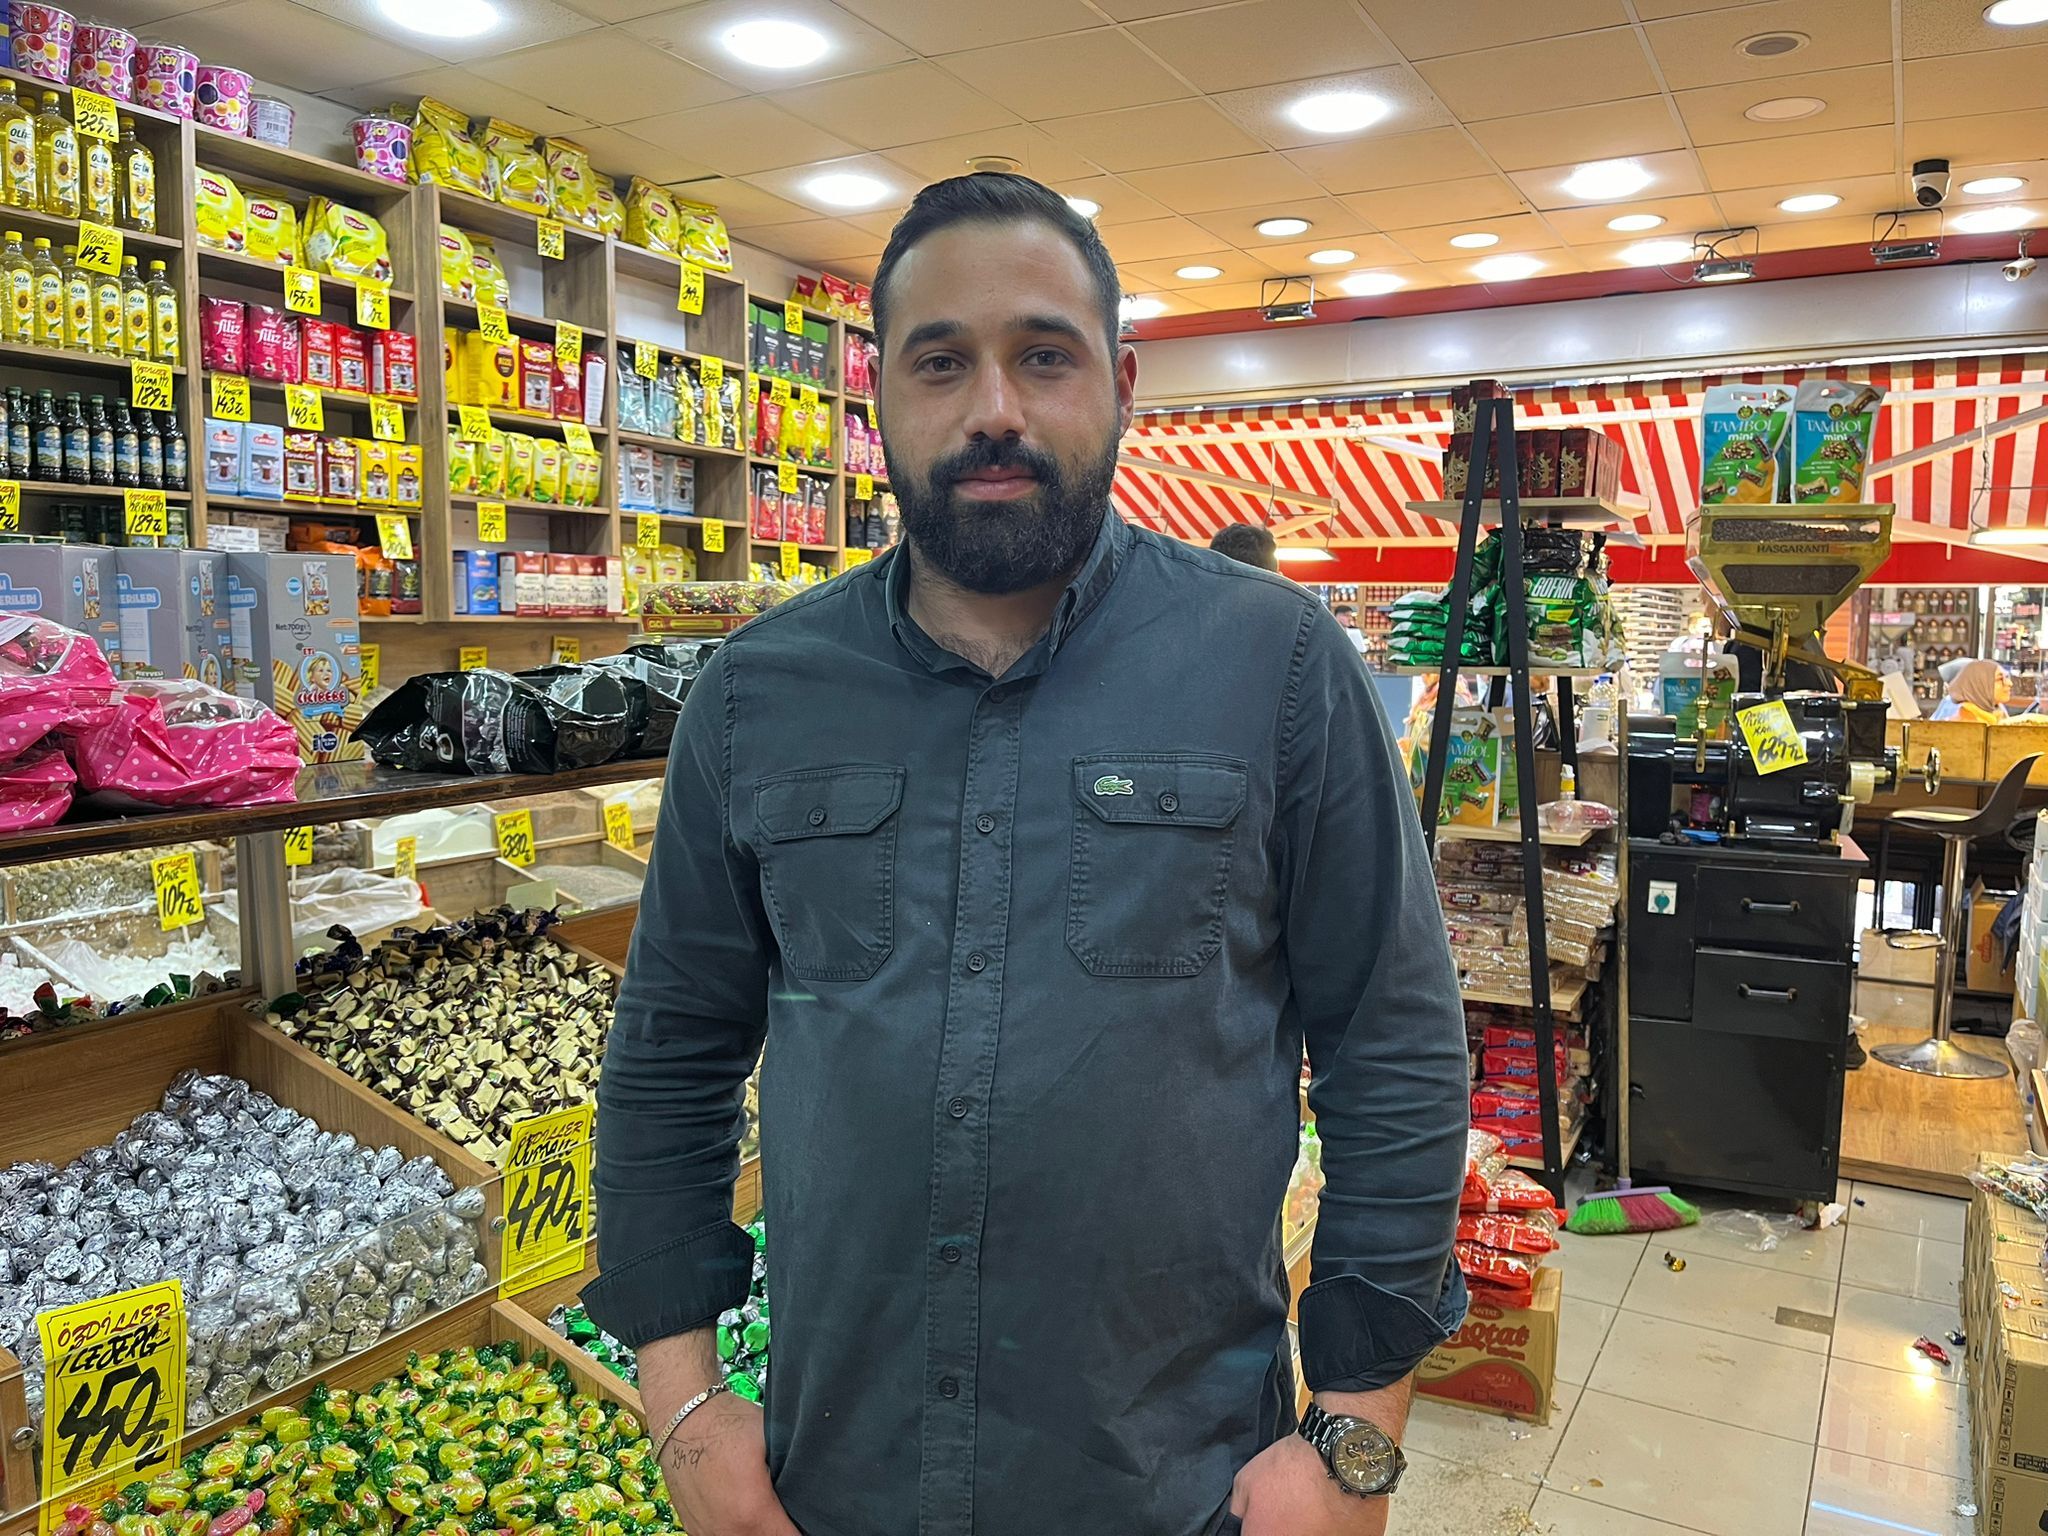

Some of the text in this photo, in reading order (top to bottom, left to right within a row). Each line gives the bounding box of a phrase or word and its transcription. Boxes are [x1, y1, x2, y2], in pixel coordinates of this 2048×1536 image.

[109, 37, 127, 50] JOY
[159, 55, 178, 67] JOY
[202, 178, 227, 197] Lipton
[252, 204, 277, 219] Lipton
[217, 319, 241, 335] filiz
[257, 328, 282, 344] filiz
[1711, 419, 1777, 433] TAMBOL
[1728, 433, 1753, 441] mini
[1824, 433, 1848, 441] mini
[1757, 543, 1830, 554] HASGARANTİ
[1448, 743, 1490, 758] AMBOL
[1508, 1039, 1535, 1048] Finger
[1505, 1066, 1533, 1076] Finger
[1496, 1106, 1524, 1119] Finger
[508, 1158, 576, 1252] 450
[58, 1303, 171, 1349] ÖZDİLLER
[57, 1363, 162, 1477] 450
